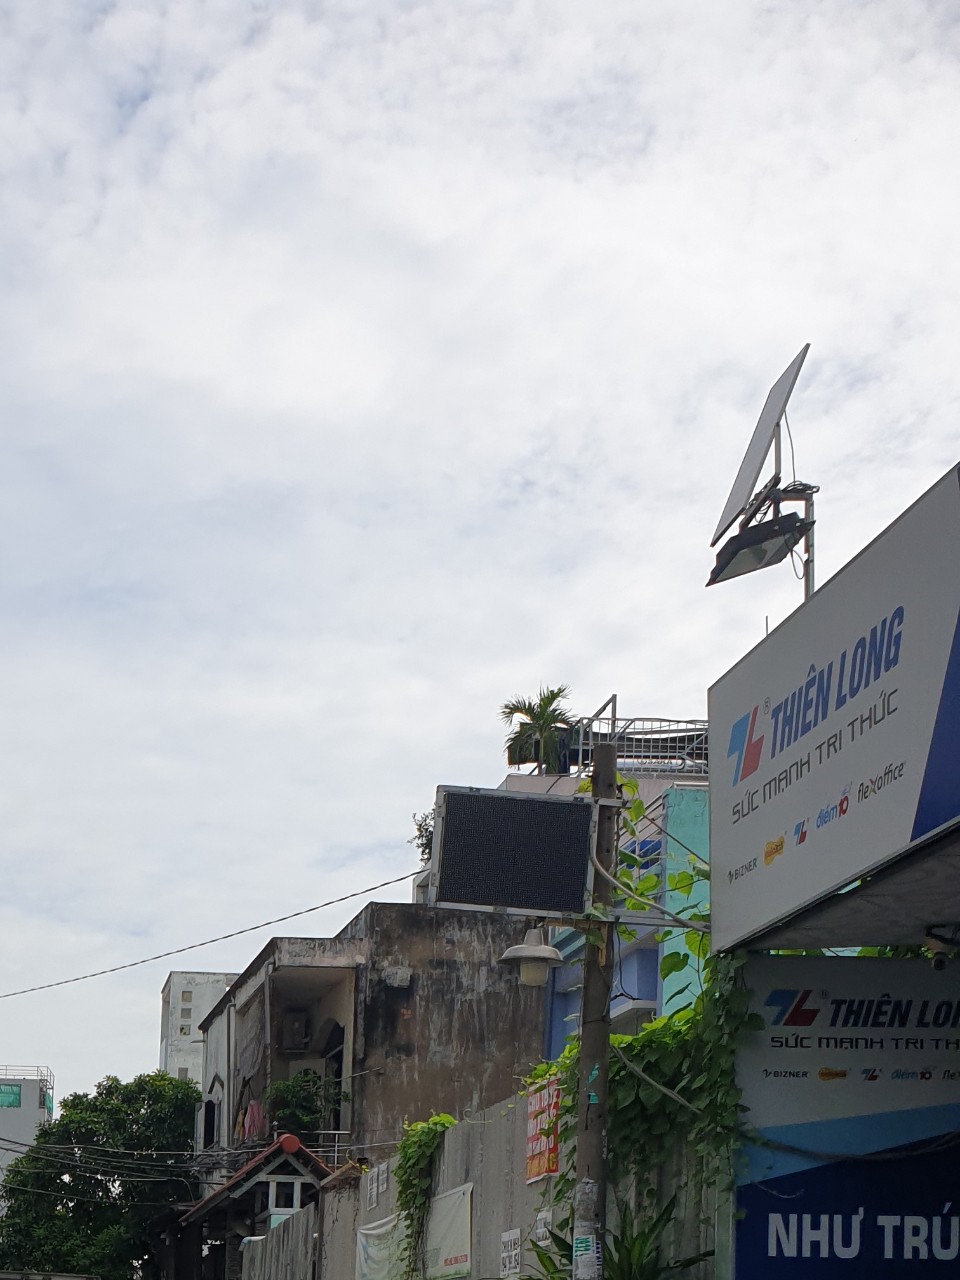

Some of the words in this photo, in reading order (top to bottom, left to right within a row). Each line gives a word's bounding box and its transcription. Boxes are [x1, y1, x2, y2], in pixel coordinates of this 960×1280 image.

[770, 660, 834, 760] THIÊN
[835, 605, 905, 711] LONG
[732, 789, 759, 825] SỨC
[763, 752, 811, 803] MẠNH
[815, 730, 842, 765] TRI
[847, 688, 898, 742] THỨC
[734, 858, 757, 880] BIZNER
[830, 993, 912, 1027] THIÊN
[771, 1033, 811, 1049] SỨC
[818, 1037, 884, 1050] MẠNH
[891, 1037, 924, 1050] TRI
[773, 1070, 808, 1079] BIZNER
[942, 1068, 960, 1081] fle
[767, 1206, 865, 1259] NHƯ
